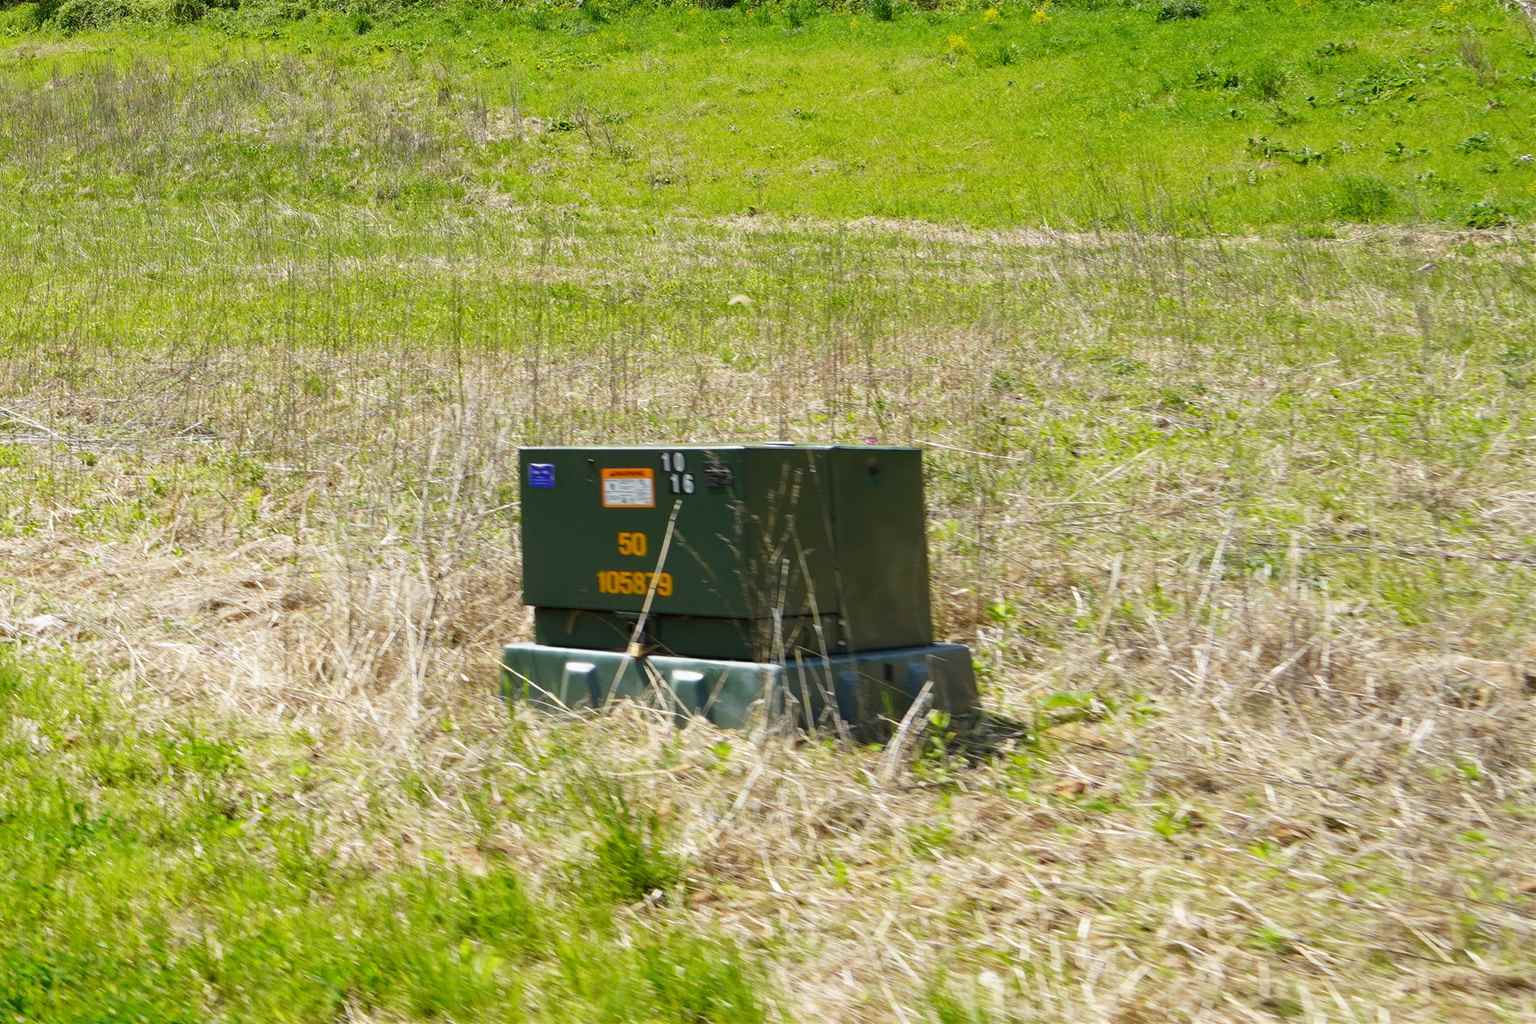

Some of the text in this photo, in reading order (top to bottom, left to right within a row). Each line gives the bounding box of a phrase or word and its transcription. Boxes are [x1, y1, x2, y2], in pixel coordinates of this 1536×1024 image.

[661, 452, 686, 472] 10
[670, 473, 694, 494] 16
[618, 532, 647, 556] 50
